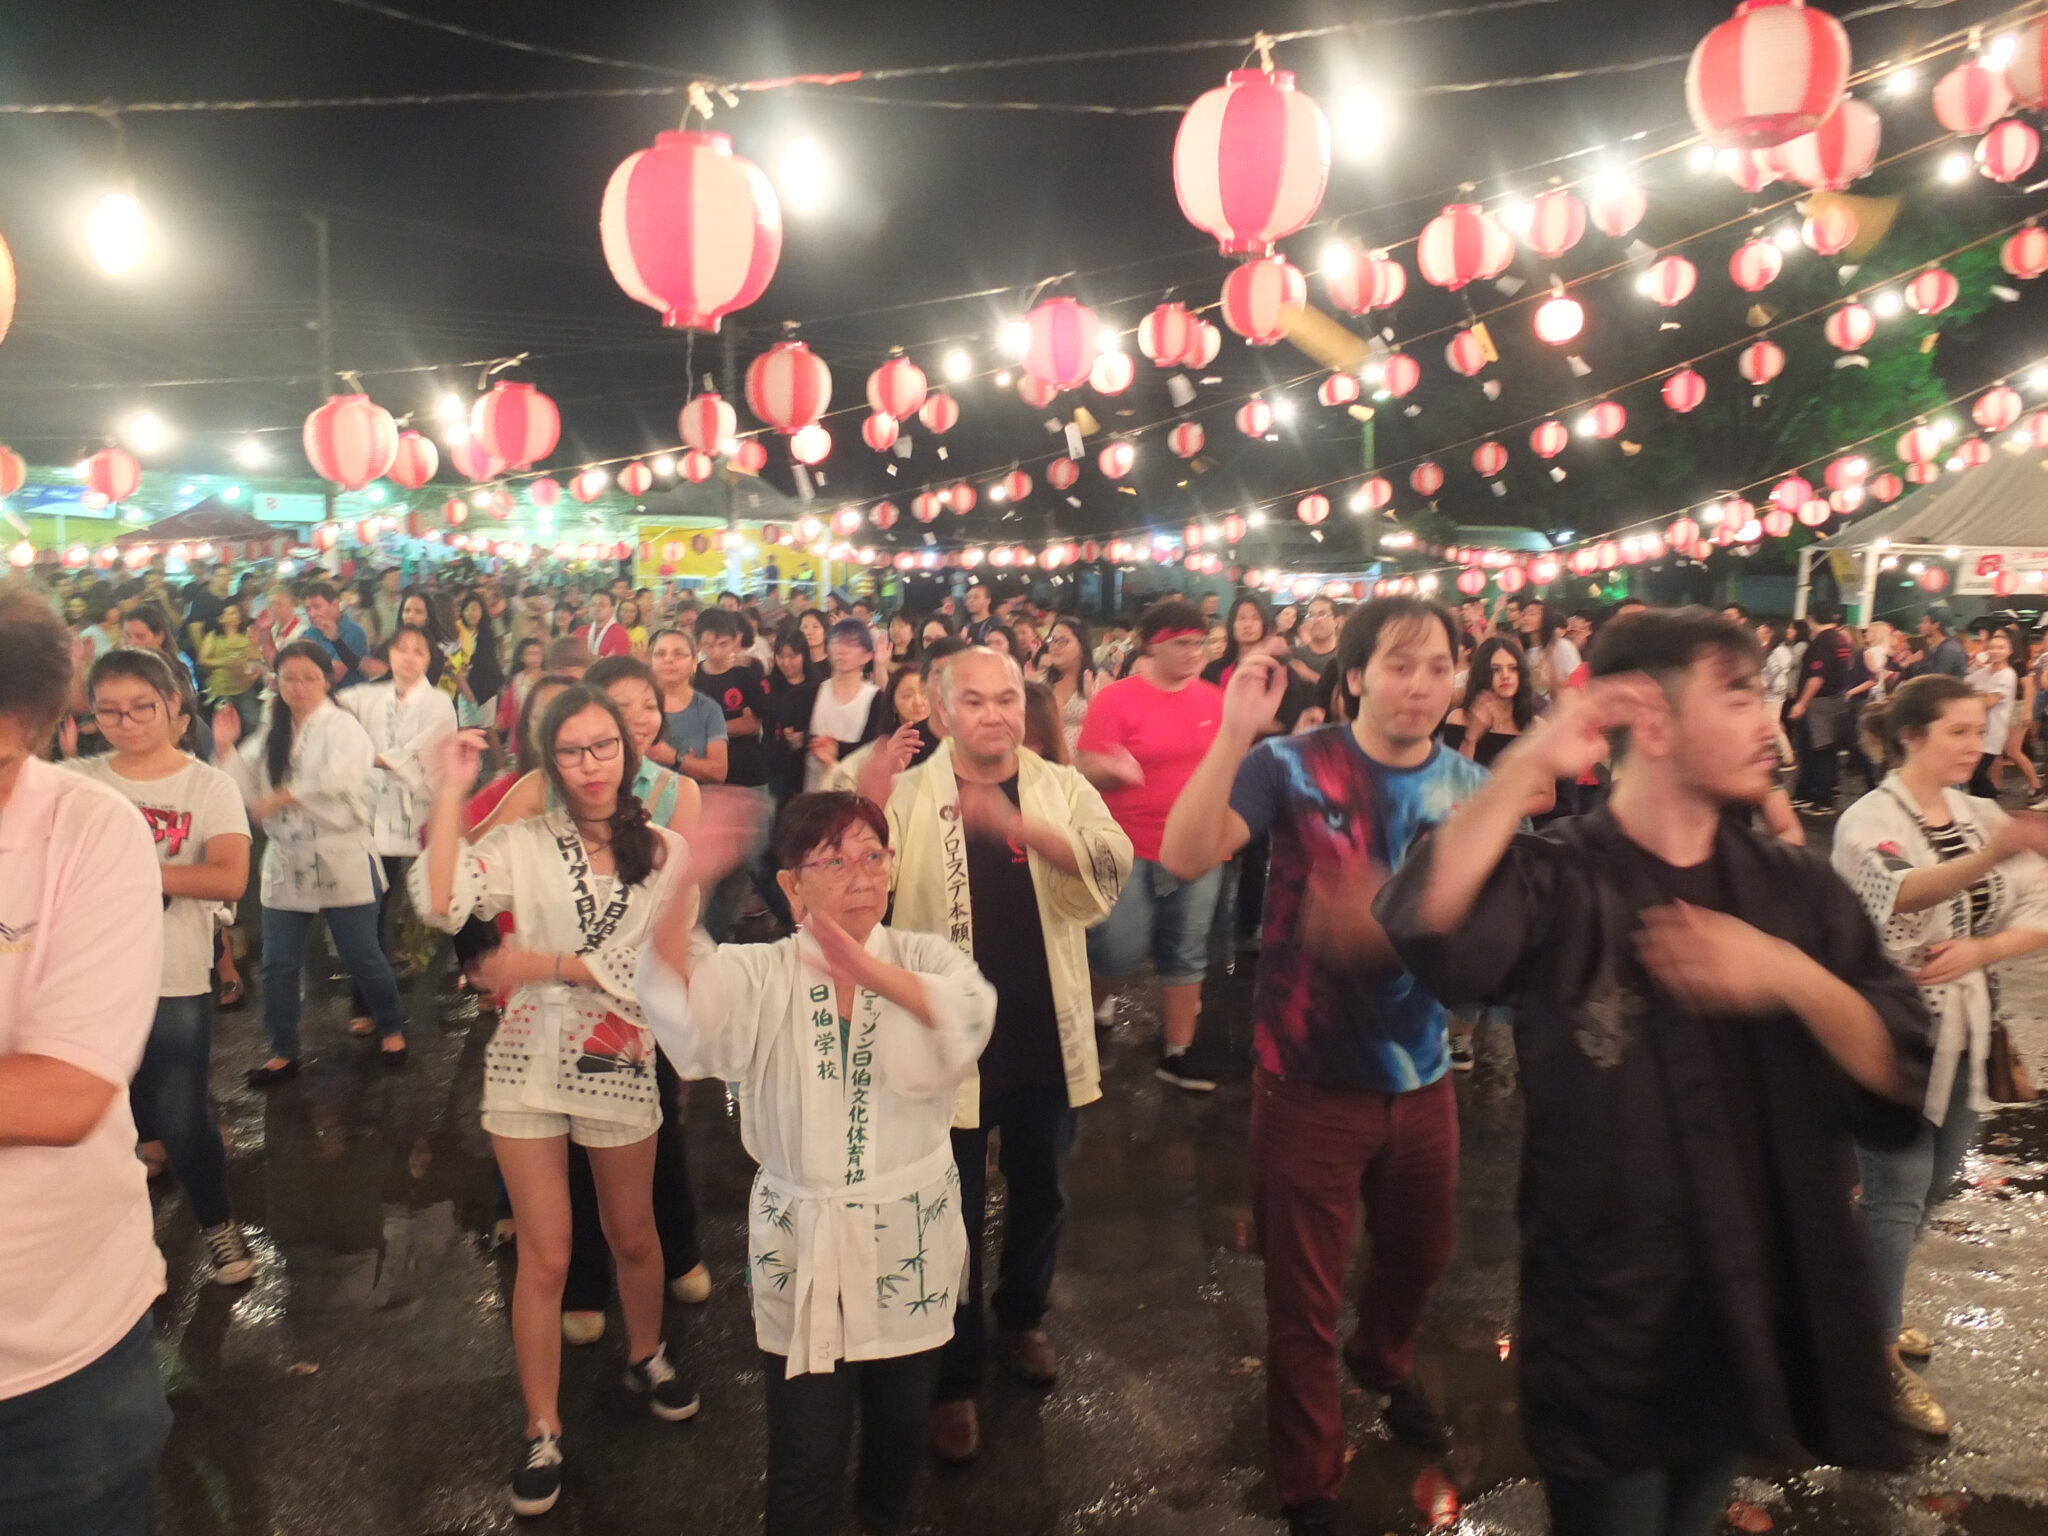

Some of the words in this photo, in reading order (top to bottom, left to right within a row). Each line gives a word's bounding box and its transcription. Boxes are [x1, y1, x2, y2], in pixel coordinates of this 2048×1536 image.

[944, 825, 971, 954] ノロエステ本願
[810, 984, 840, 1080] 日伯学校
[844, 987, 881, 1208] ロミッソン日伯文化体育協
